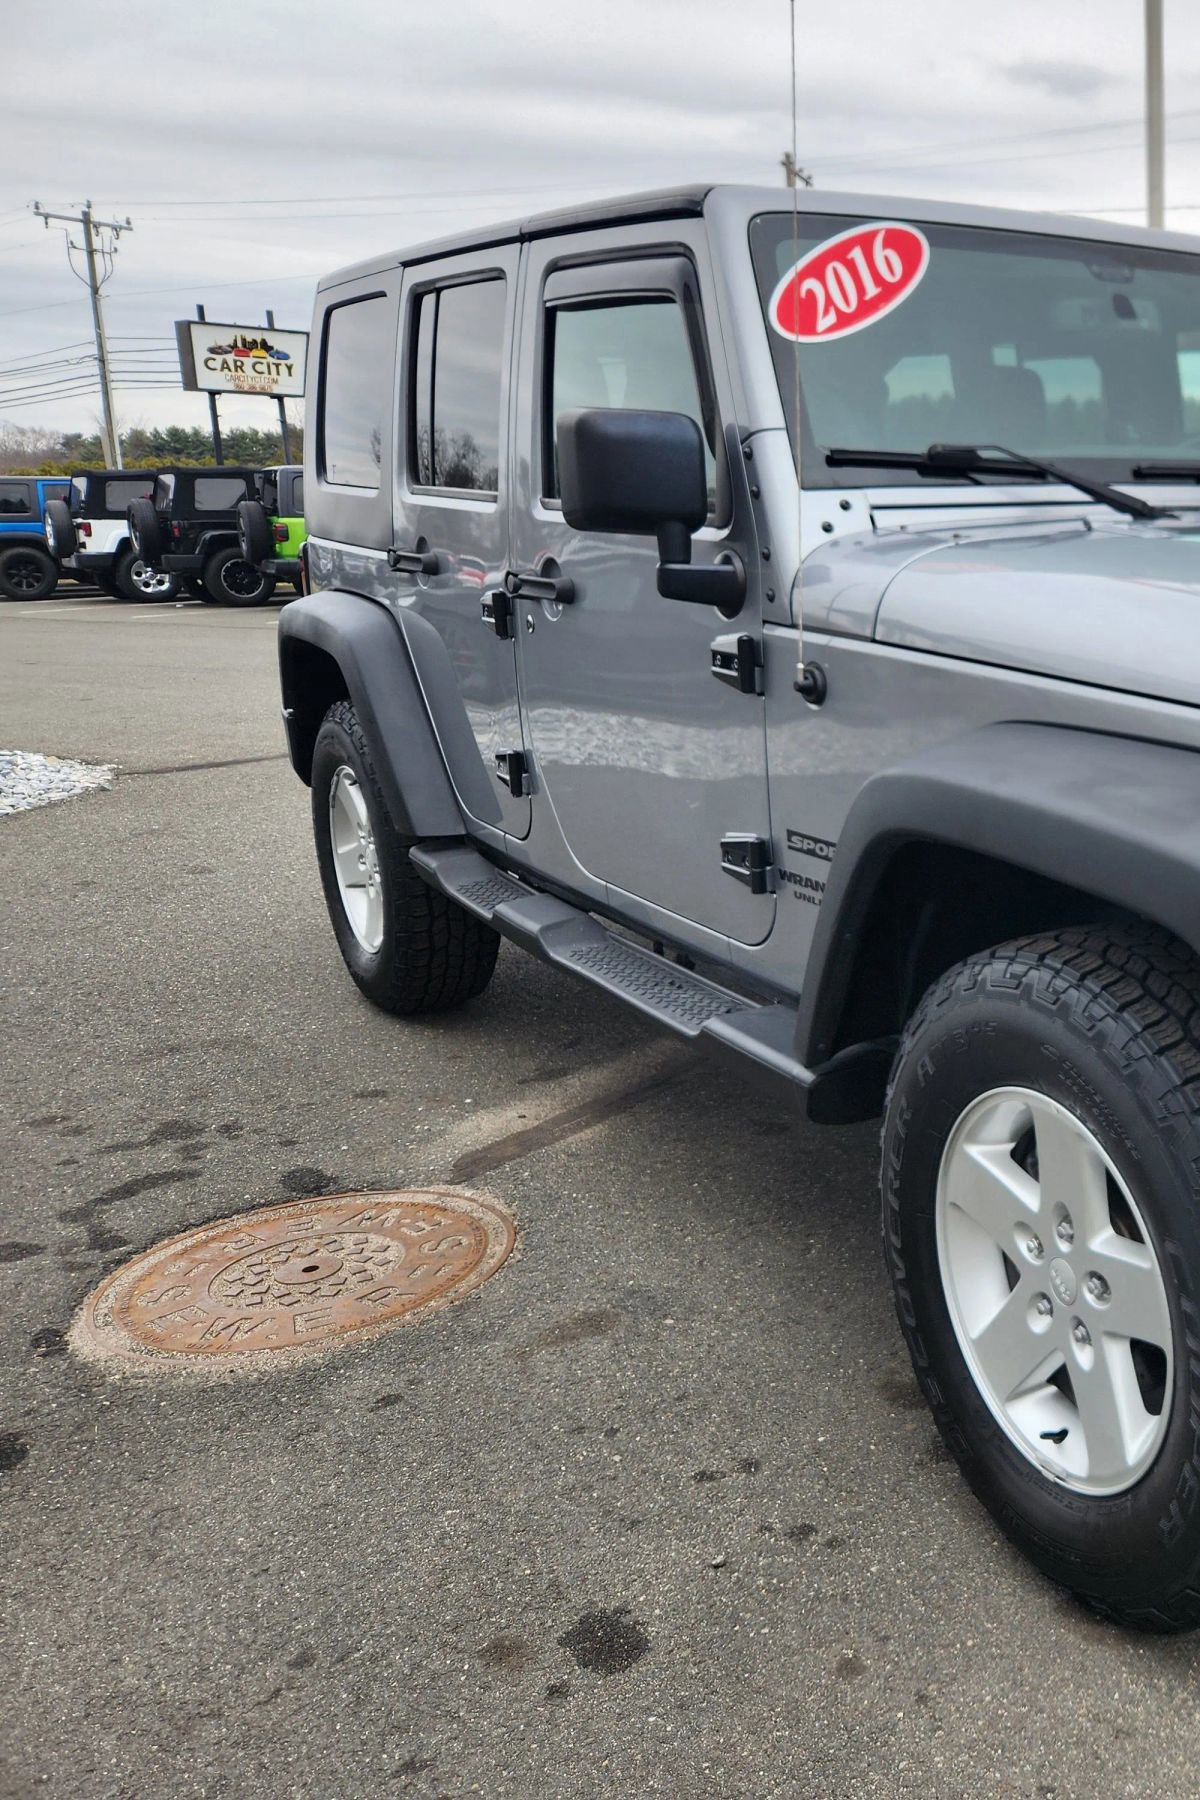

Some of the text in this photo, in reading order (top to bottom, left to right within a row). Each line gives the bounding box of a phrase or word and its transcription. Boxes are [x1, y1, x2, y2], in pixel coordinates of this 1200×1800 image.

[801, 229, 903, 333] 2016
[203, 357, 294, 377] CAR CITY
[136, 1284, 416, 1343] SEWER
